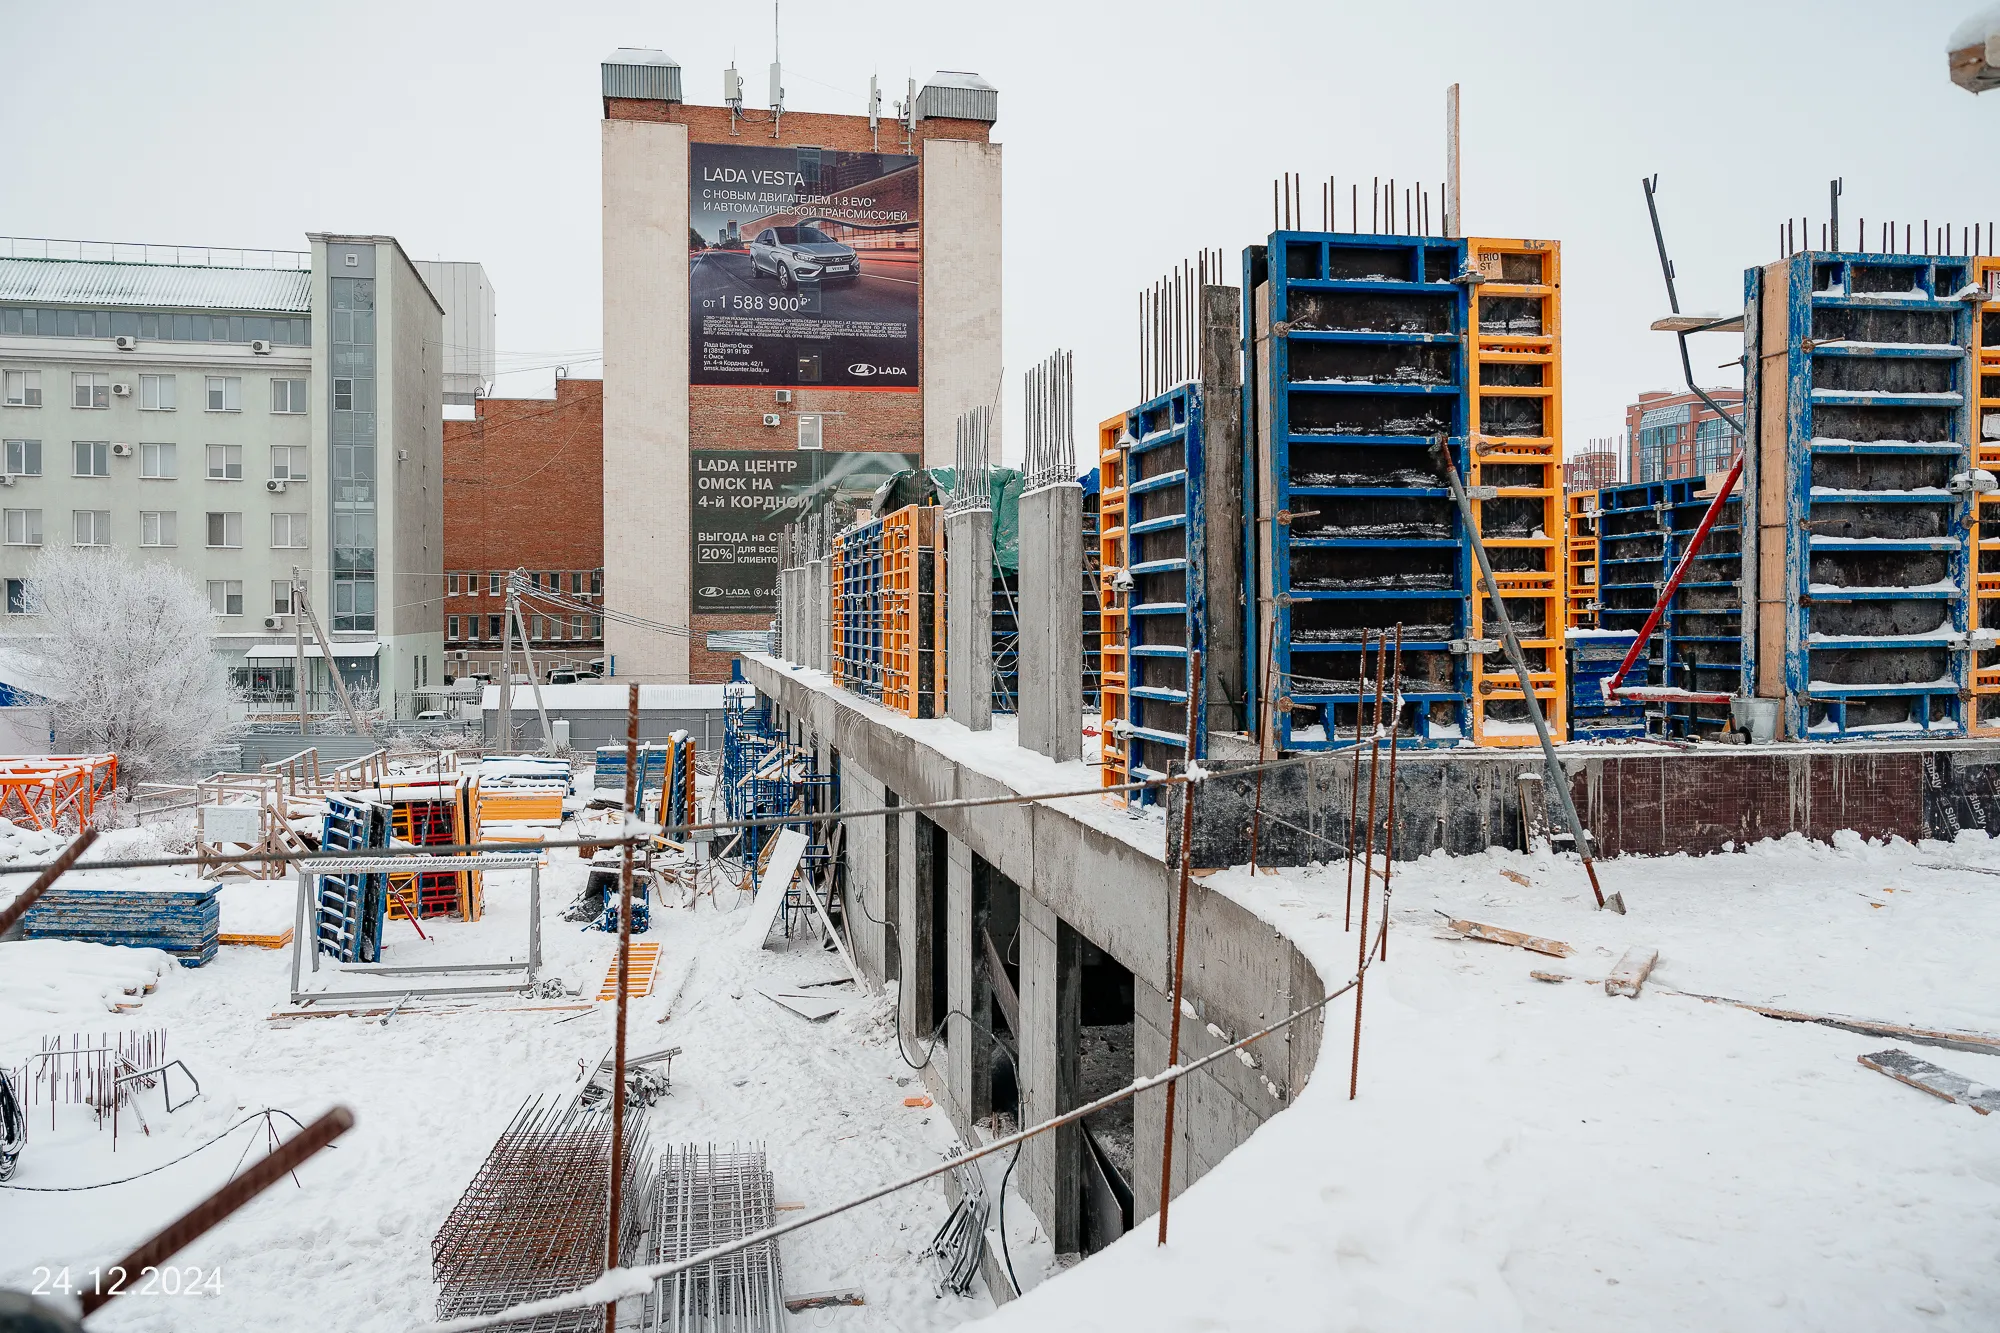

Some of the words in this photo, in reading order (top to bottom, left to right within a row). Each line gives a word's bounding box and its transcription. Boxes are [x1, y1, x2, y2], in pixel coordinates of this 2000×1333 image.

[704, 167, 748, 184] LADA
[751, 170, 806, 188] VESTA
[702, 189, 711, 199] С
[713, 190, 756, 201] НОВЫМ
[758, 192, 830, 205] ДВИГАТЕЛЕМ
[834, 196, 849, 206] 1.8
[703, 202, 711, 211] И
[713, 203, 817, 217] АВТОМАТИЧЕСКОЙ
[819, 207, 908, 221] ТРАНСМИССИЕЙ
[1478, 252, 1499, 262] TRIO
[1480, 262, 1492, 271] ST
[702, 299, 716, 308] от
[720, 295, 726, 309] 1
[733, 295, 764, 310] 588
[768, 296, 799, 312] 900
[719, 342, 737, 350] Центр
[878, 366, 908, 376] LADA
[698, 459, 740, 472] LADA
[744, 460, 798, 475] ЦЕНТР
[698, 477, 747, 490] ОМСК
[752, 478, 774, 490] НА
[698, 495, 725, 508] 4-й
[698, 532, 748, 543] ВЫГОДА
[751, 533, 765, 541] на
[701, 548, 733, 560] 20%
[737, 556, 779, 564] КЛИЕНТО
[725, 588, 751, 596] LADA
[1924, 757, 1942, 788] SibPly
[1968, 793, 1987, 826] SibPly
